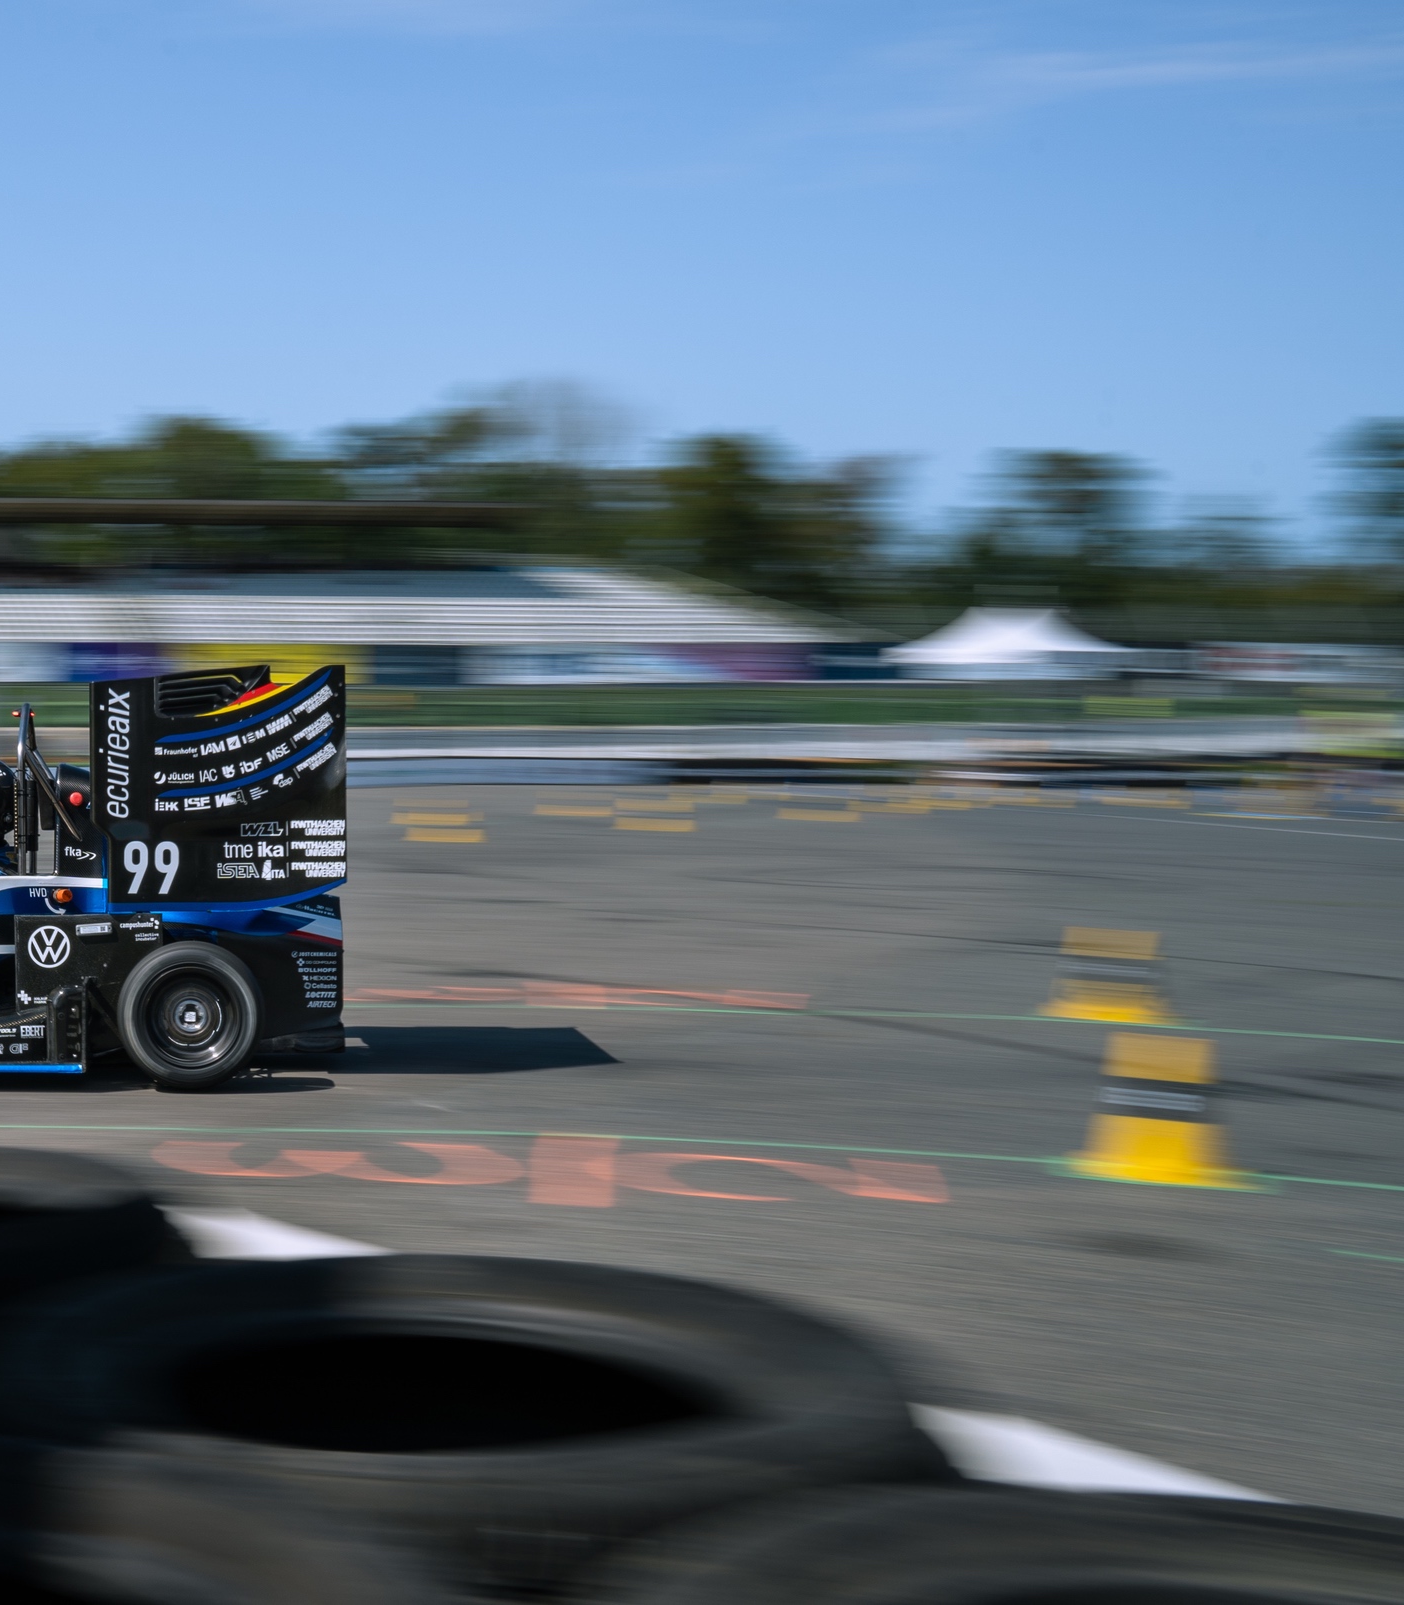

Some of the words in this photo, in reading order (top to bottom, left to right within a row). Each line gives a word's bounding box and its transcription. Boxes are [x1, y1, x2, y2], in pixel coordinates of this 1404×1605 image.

[99, 687, 131, 819] ecurieaix
[163, 747, 198, 755] Fraunhofer
[266, 742, 291, 763] MSE
[167, 772, 195, 780] JÜLICH
[199, 768, 218, 783] IAC
[240, 821, 284, 837] WZL
[304, 828, 345, 836] UNIVERSITY
[65, 846, 82, 857] fka
[223, 841, 254, 858] tme
[257, 841, 285, 857] ika
[305, 849, 345, 857] UNIVERSITY
[123, 840, 180, 895] 99
[305, 870, 346, 878] UNIVERSITY
[29, 888, 48, 898] HVD
[20, 1025, 46, 1037] EBERT
